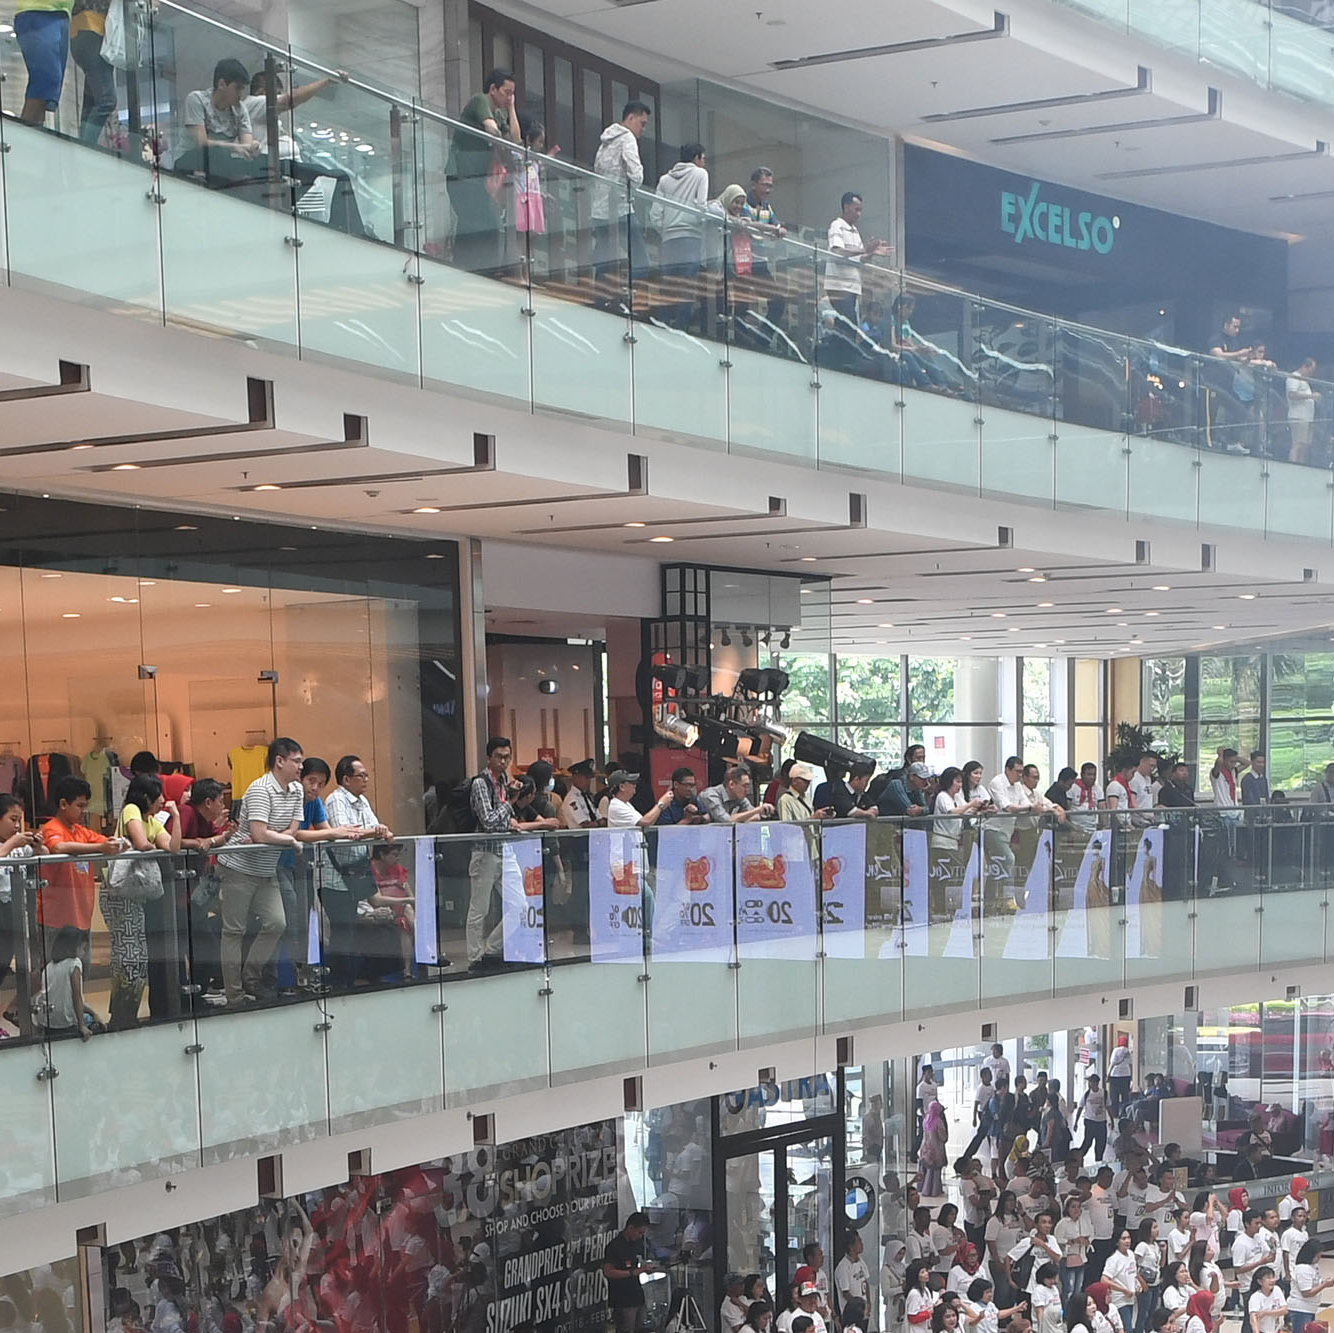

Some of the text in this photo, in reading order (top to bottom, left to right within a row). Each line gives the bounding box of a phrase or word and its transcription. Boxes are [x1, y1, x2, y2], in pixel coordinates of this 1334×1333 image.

[1001, 182, 1114, 254] EXCELSO
[485, 1221, 509, 1238] SHOP
[511, 1214, 529, 1230] AND
[531, 1203, 564, 1225] CHOOSE
[504, 1242, 565, 1289] GRANDPRIZE
[535, 1280, 560, 1324] SX4
